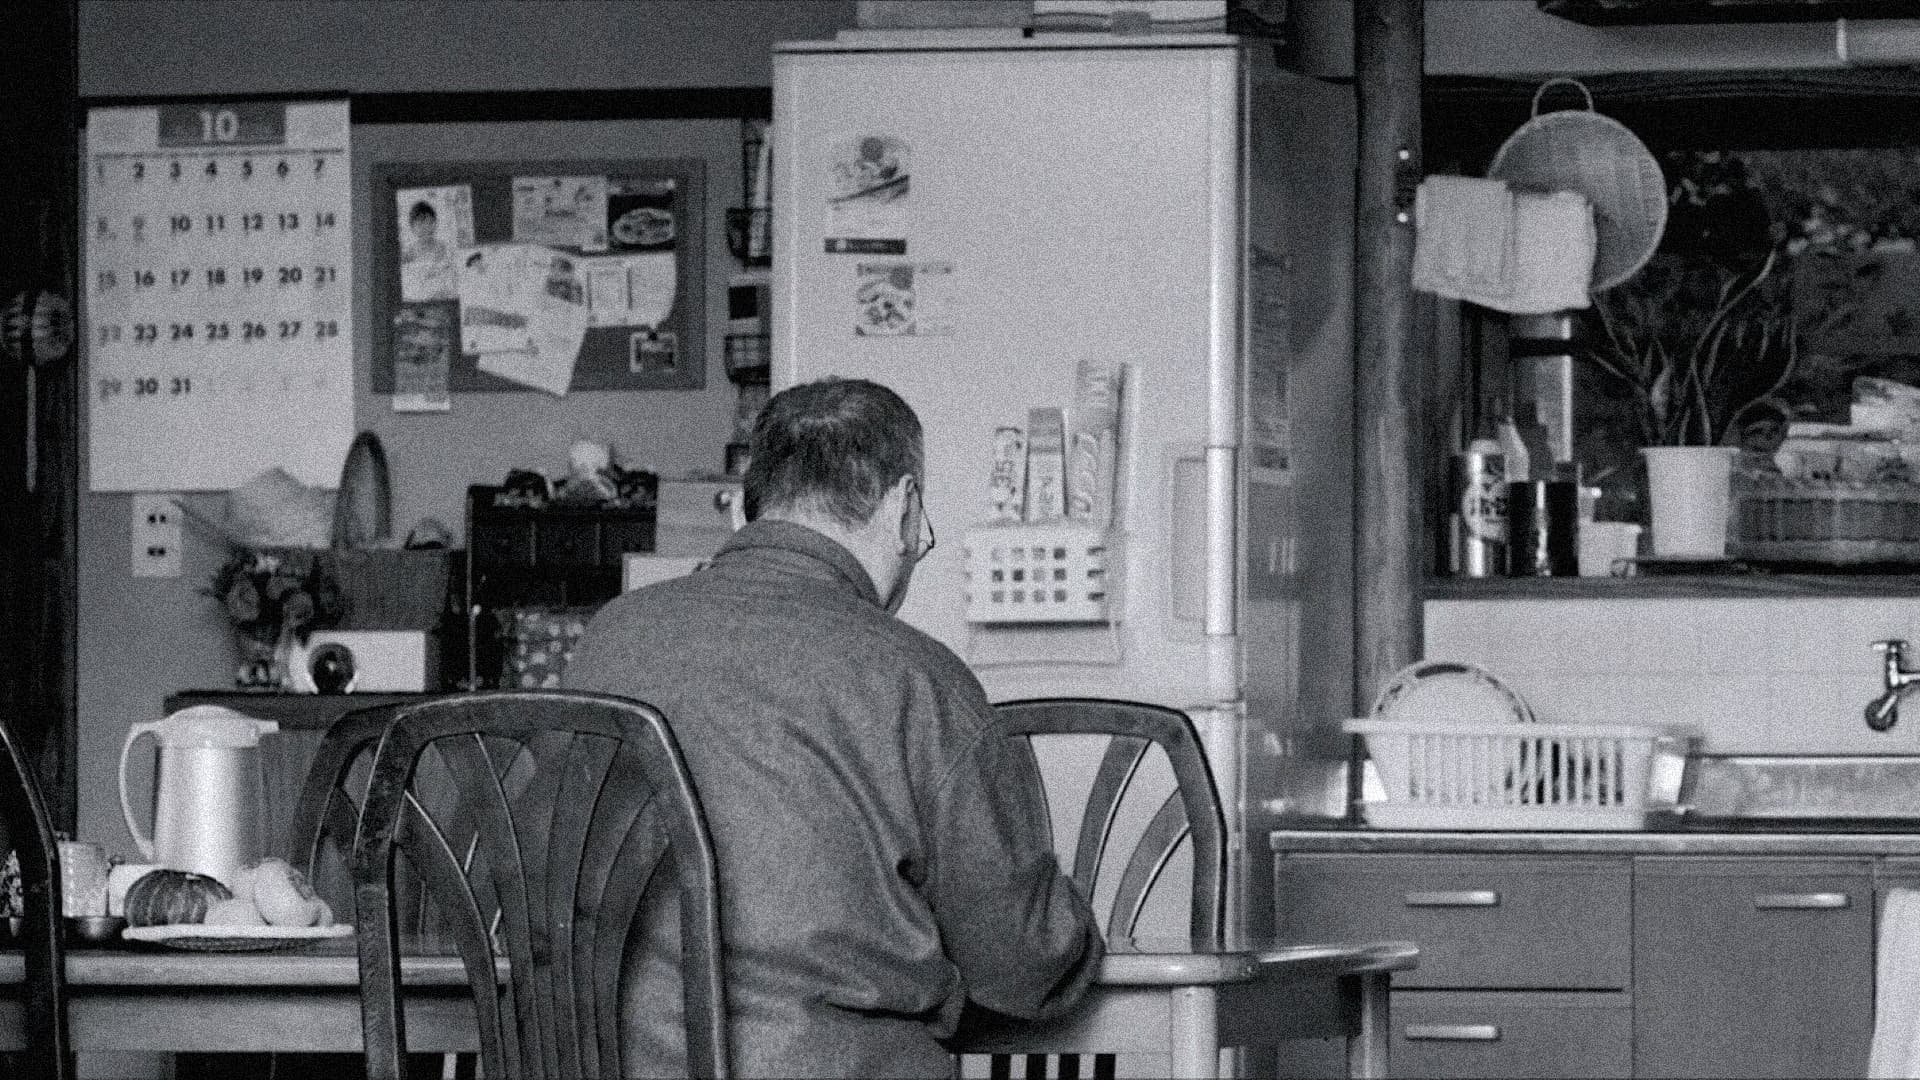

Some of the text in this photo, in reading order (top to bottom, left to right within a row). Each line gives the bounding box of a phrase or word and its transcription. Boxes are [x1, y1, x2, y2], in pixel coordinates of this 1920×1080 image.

[199, 110, 238, 142] 10
[132, 161, 145, 179] 2
[170, 161, 182, 178] 3
[205, 161, 218, 176] 4
[242, 160, 254, 177] 5
[277, 160, 290, 177] 6
[314, 158, 325, 174] 7
[170, 215, 192, 231] 10
[206, 214, 225, 230] 11
[242, 214, 263, 230] 12
[278, 213, 299, 229] 13
[315, 212, 336, 228] 14
[134, 270, 155, 286] 16
[170, 269, 191, 285] 17
[206, 268, 226, 284] 18
[243, 268, 264, 284] 19
[278, 267, 302, 283] 20
[315, 267, 336, 282] 21
[134, 324, 158, 341] 23
[170, 323, 194, 340] 24
[206, 322, 230, 339] 25
[242, 322, 267, 339] 26
[278, 321, 302, 337] 27
[315, 321, 339, 337] 28
[134, 378, 158, 394] 30
[170, 377, 191, 393] 31
